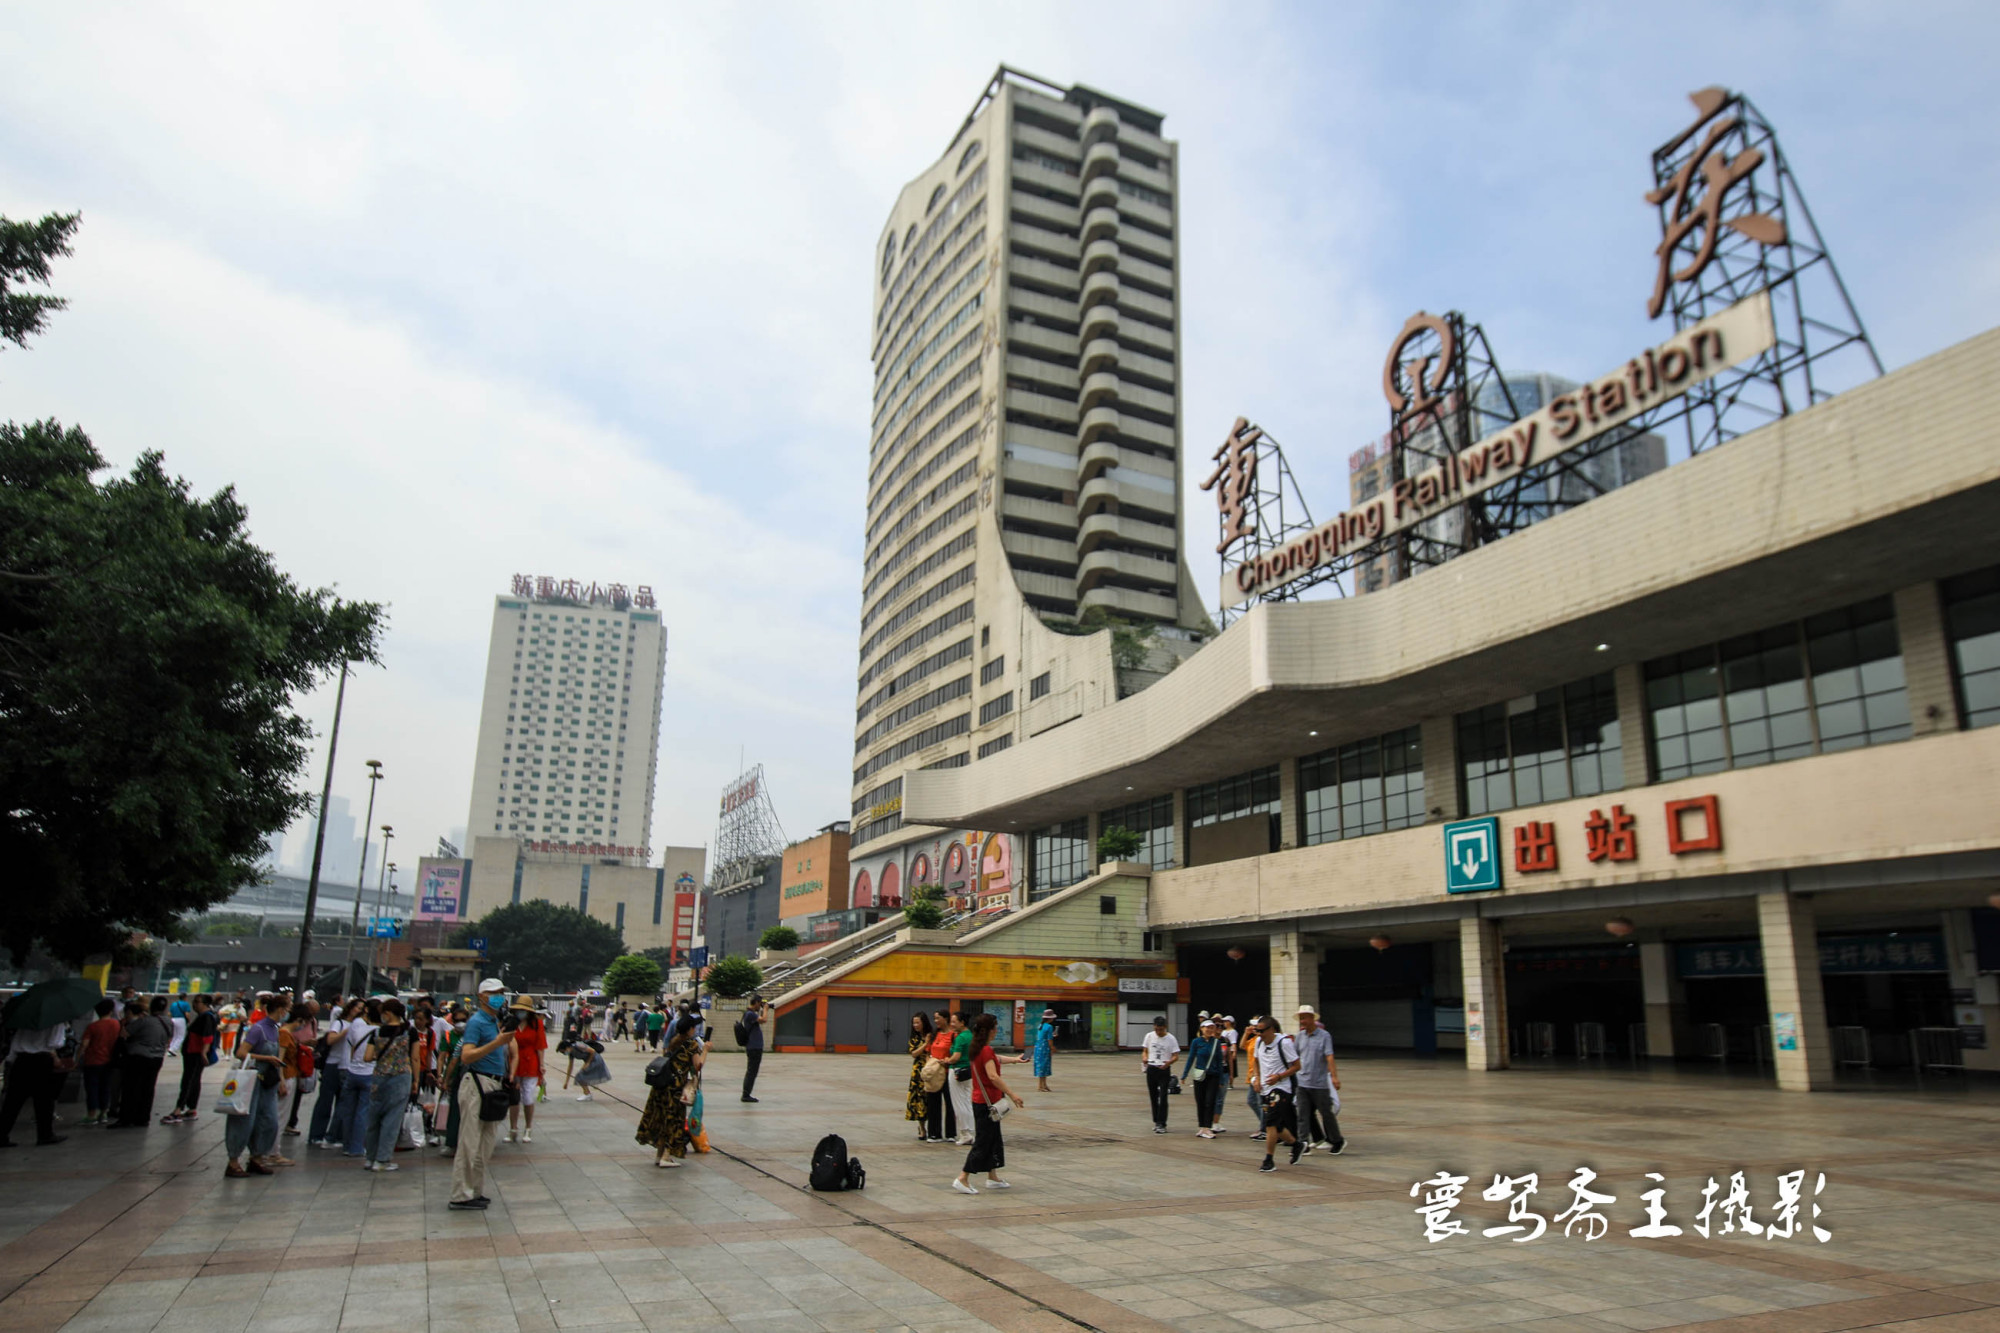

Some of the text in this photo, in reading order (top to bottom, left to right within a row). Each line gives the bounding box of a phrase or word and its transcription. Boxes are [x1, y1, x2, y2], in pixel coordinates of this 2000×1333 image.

[1200, 85, 1787, 555] 重 庆
[1236, 323, 1725, 594] Chongqing Railway Station
[1514, 794, 1723, 873] 出站口
[1695, 946, 1763, 971] 接车人
